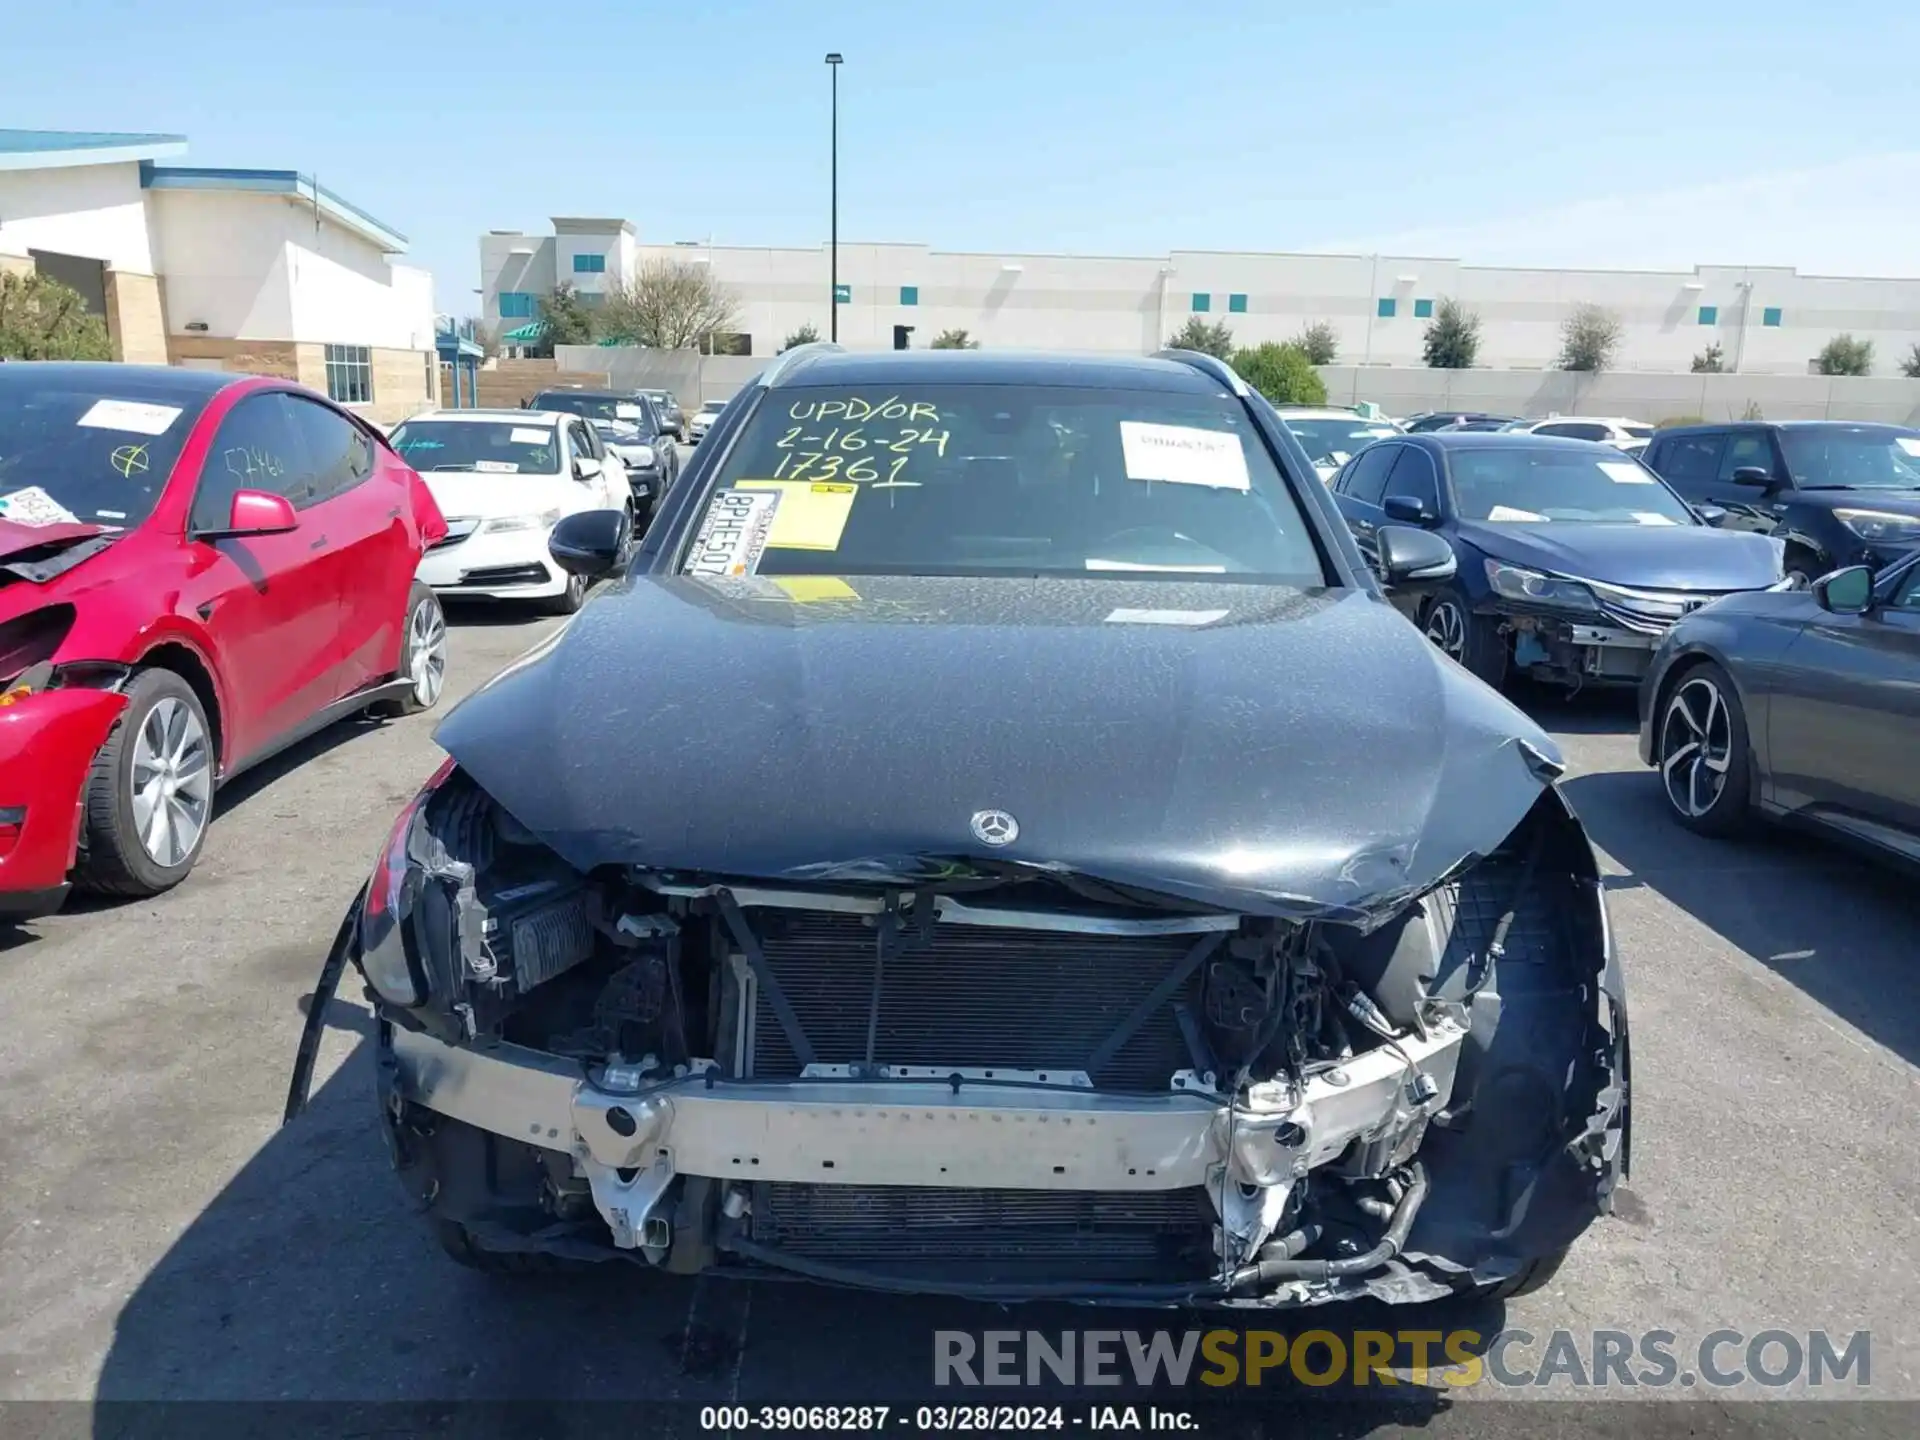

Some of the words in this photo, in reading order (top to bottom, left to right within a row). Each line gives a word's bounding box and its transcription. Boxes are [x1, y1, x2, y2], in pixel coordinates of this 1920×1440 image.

[776, 426, 950, 457] 2-16-24
[773, 452, 923, 488] 17361
[695, 495, 755, 576] 8PHE507
